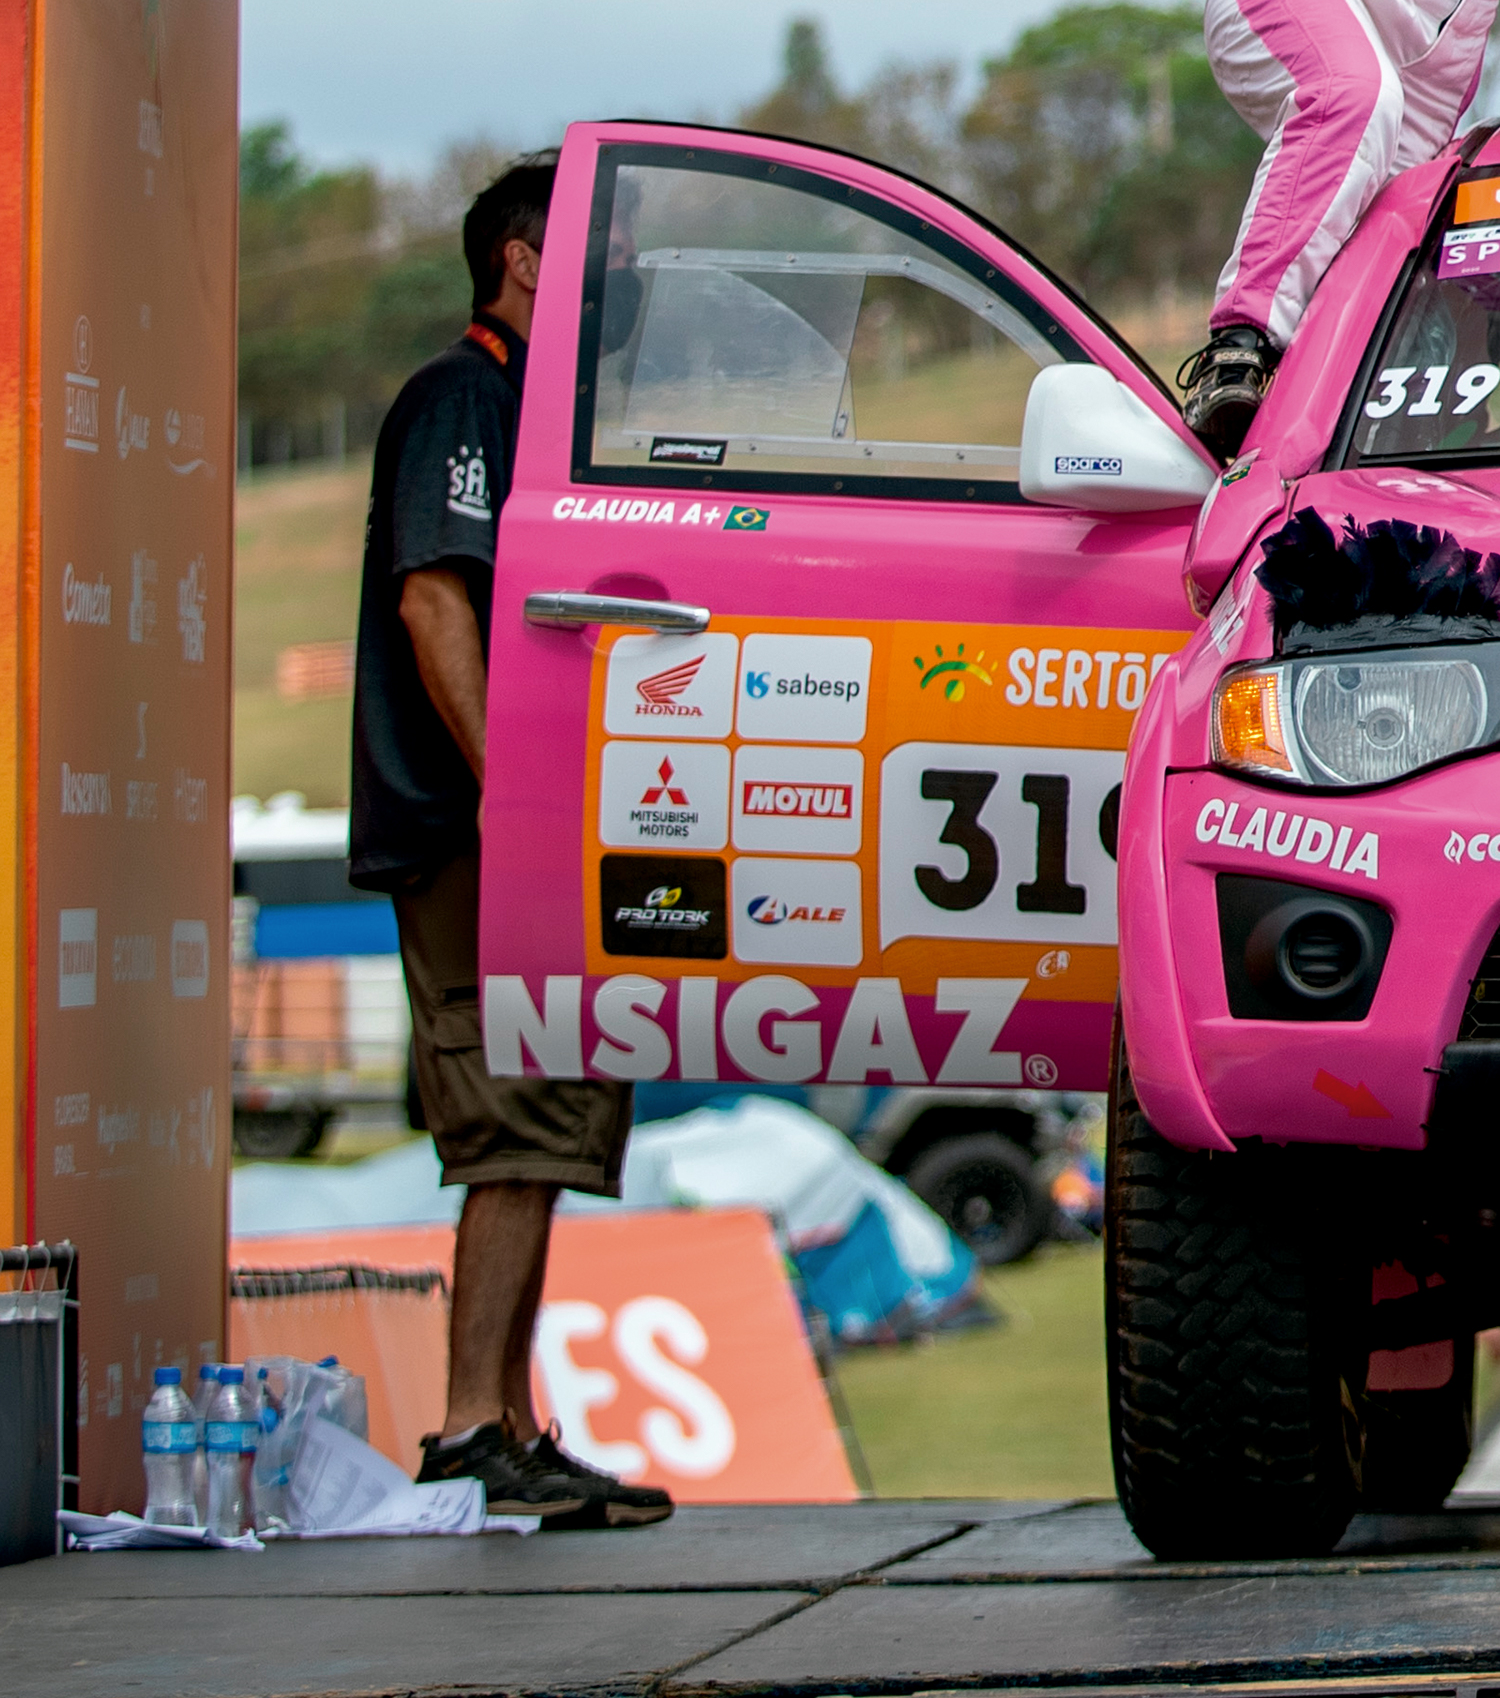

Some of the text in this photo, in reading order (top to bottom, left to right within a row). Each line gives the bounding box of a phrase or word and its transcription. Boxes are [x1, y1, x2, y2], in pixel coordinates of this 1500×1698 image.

[1056, 457, 1122, 474] sparco
[552, 498, 721, 526] CLAUDIA A+
[776, 673, 861, 702] sabesp
[635, 703, 704, 717] HONDA
[745, 785, 849, 816] MOTUL
[630, 810, 699, 824] MITSUBISHI
[639, 824, 689, 837] MOTORS
[1195, 798, 1380, 880] CLAUDIA
[615, 907, 713, 923] PRO TORK
[788, 906, 847, 923] ALE
